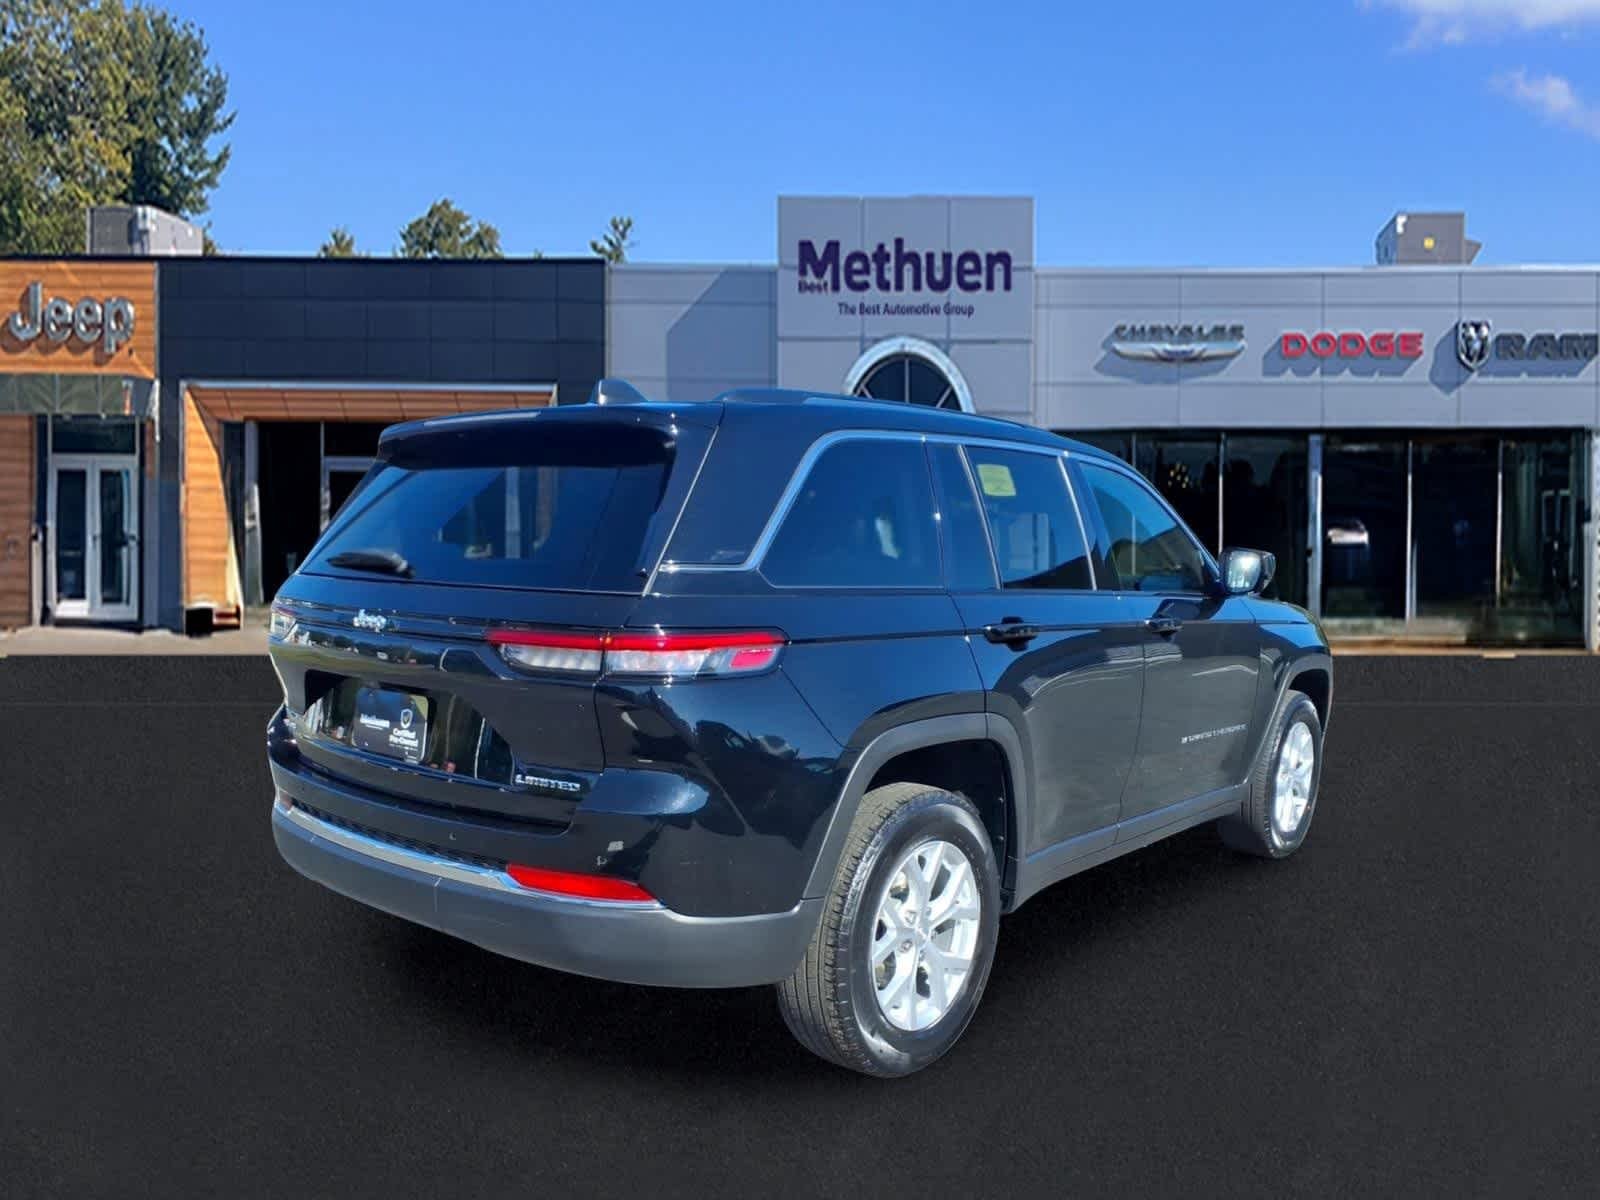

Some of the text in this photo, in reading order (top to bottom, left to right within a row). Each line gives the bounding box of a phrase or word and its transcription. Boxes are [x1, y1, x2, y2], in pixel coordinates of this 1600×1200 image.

[798, 237, 1012, 293] Methuen
[798, 279, 829, 294] Best
[9, 281, 135, 355] Jeep
[838, 302, 975, 318] The Best Automotive Group
[1114, 324, 1245, 340] CHRYSLER
[1281, 332, 1424, 357] DODGE
[1495, 332, 1598, 360] RAM
[353, 608, 387, 633] Jeep
[515, 774, 581, 792] LIMITED
